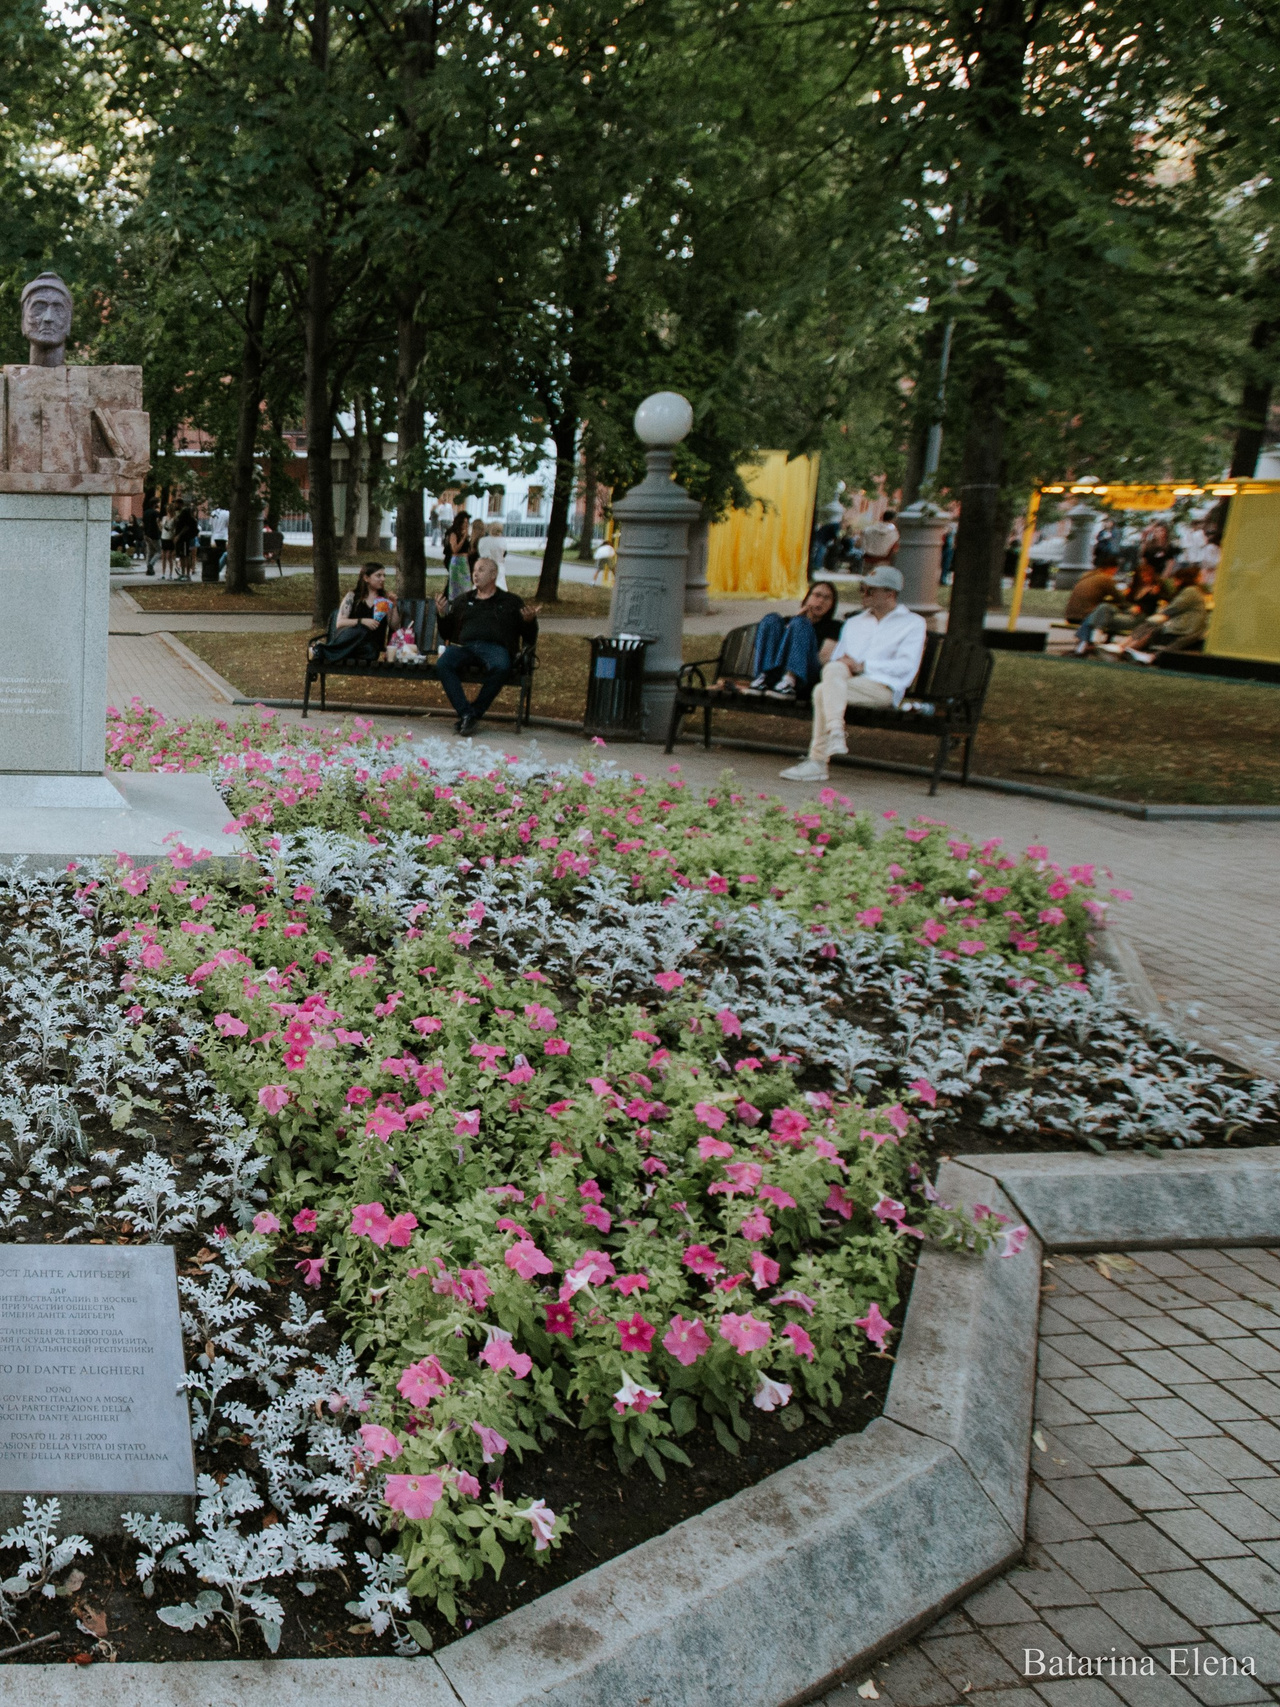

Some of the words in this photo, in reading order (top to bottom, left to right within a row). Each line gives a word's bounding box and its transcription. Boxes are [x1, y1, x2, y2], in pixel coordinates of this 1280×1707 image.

[23, 1269, 64, 1279] ДАНТЕ
[67, 1270, 131, 1280] АЛИГЬЕРИ
[1, 1303, 20, 1311] ПРИ
[22, 1303, 64, 1311] УЧАСТИИ
[1, 1311, 35, 1319] ИМЕНИ
[54, 1328, 99, 1336] 28.11.2000
[24, 1344, 91, 1353] ИТАЛЬЯНСКОЙ
[93, 1346, 154, 1354] РЕСПУБЛИКИ
[17, 1365, 30, 1375] DI
[34, 1365, 77, 1375] DANTE
[79, 1366, 145, 1376] ALIGHIERI
[45, 1386, 72, 1394] DONO
[50, 1395, 93, 1403] ITALIANO
[104, 1396, 135, 1404] MOSCA
[8, 1404, 19, 1412] LA
[21, 1404, 99, 1413] PARTECIPAZIONE
[102, 1405, 132, 1413] DELLA
[38, 1413, 70, 1422] DANTE
[71, 1414, 120, 1422] ALIGHIERI
[10, 1432, 46, 1440] POSATO
[59, 1433, 108, 1441] 28.11.2000
[39, 1442, 70, 1450] DELLA
[72, 1442, 103, 1450] VISITA
[105, 1442, 116, 1450] DI
[117, 1442, 147, 1451] STATO
[31, 1452, 62, 1460] DELLA
[64, 1452, 122, 1461] REPUBBLICA
[124, 1453, 169, 1461] ITALIANA
